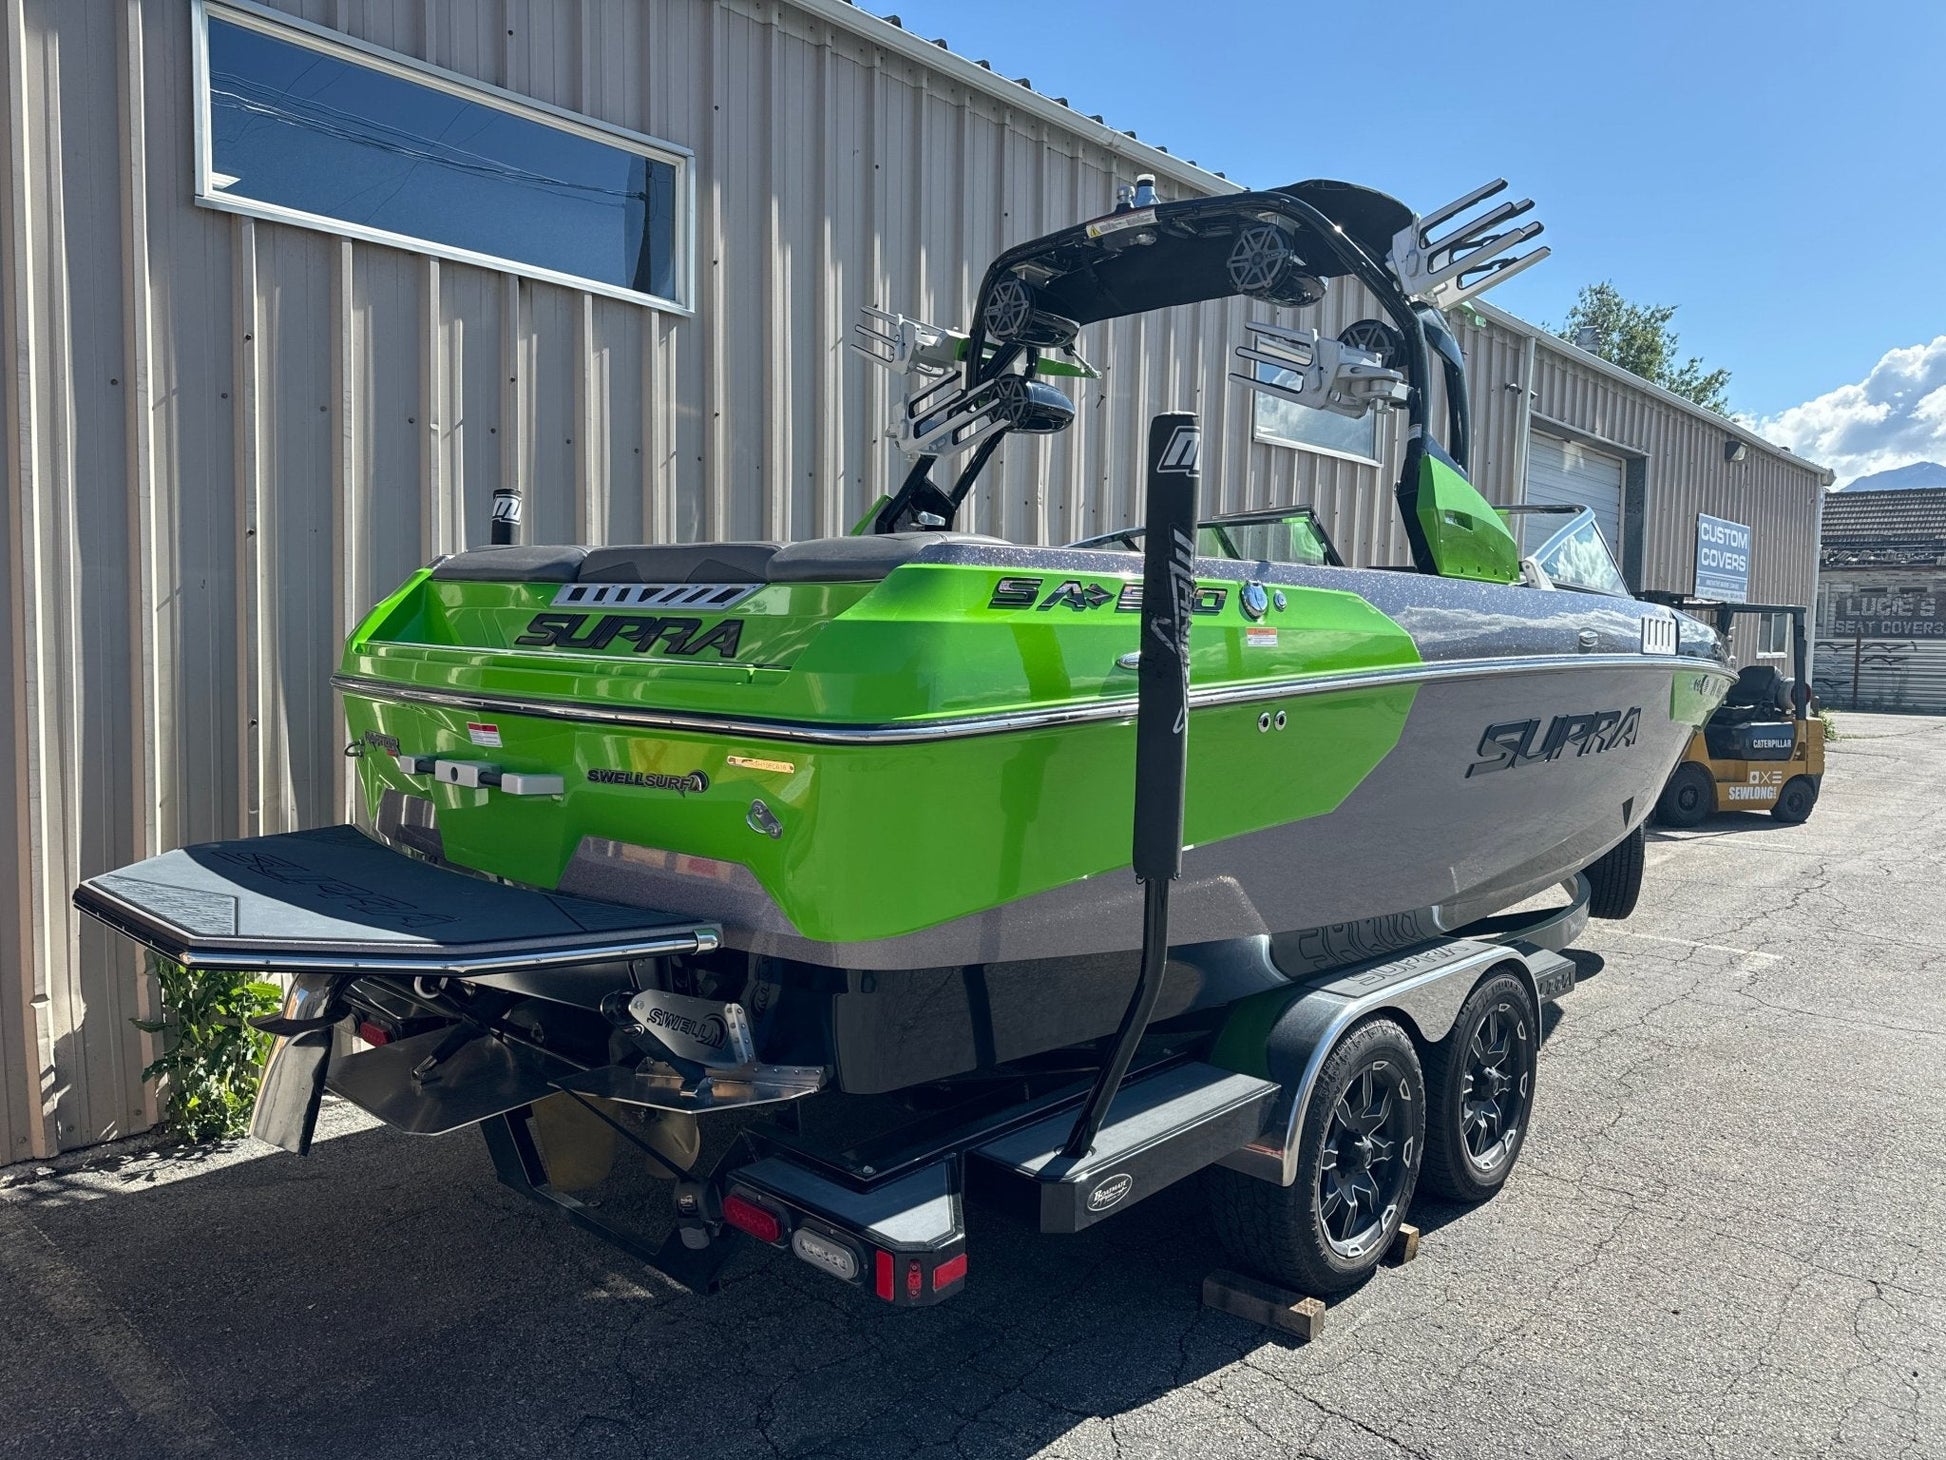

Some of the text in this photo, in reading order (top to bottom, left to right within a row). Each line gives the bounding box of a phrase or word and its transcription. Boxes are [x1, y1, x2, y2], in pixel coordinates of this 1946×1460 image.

[1701, 522, 1748, 549] CUSTOM
[1701, 547, 1746, 572] COVERS
[988, 577, 1087, 612] SA
[514, 612, 745, 658] SUPRA
[1835, 620, 1945, 635] SEAT COVERS
[1464, 706, 1642, 779] SUPRA
[1752, 738, 1792, 749] CATERPILLAR
[586, 767, 692, 794] SWELLSURF
[1728, 785, 1774, 800] SEWLONG
[647, 1008, 709, 1044] SWELL
